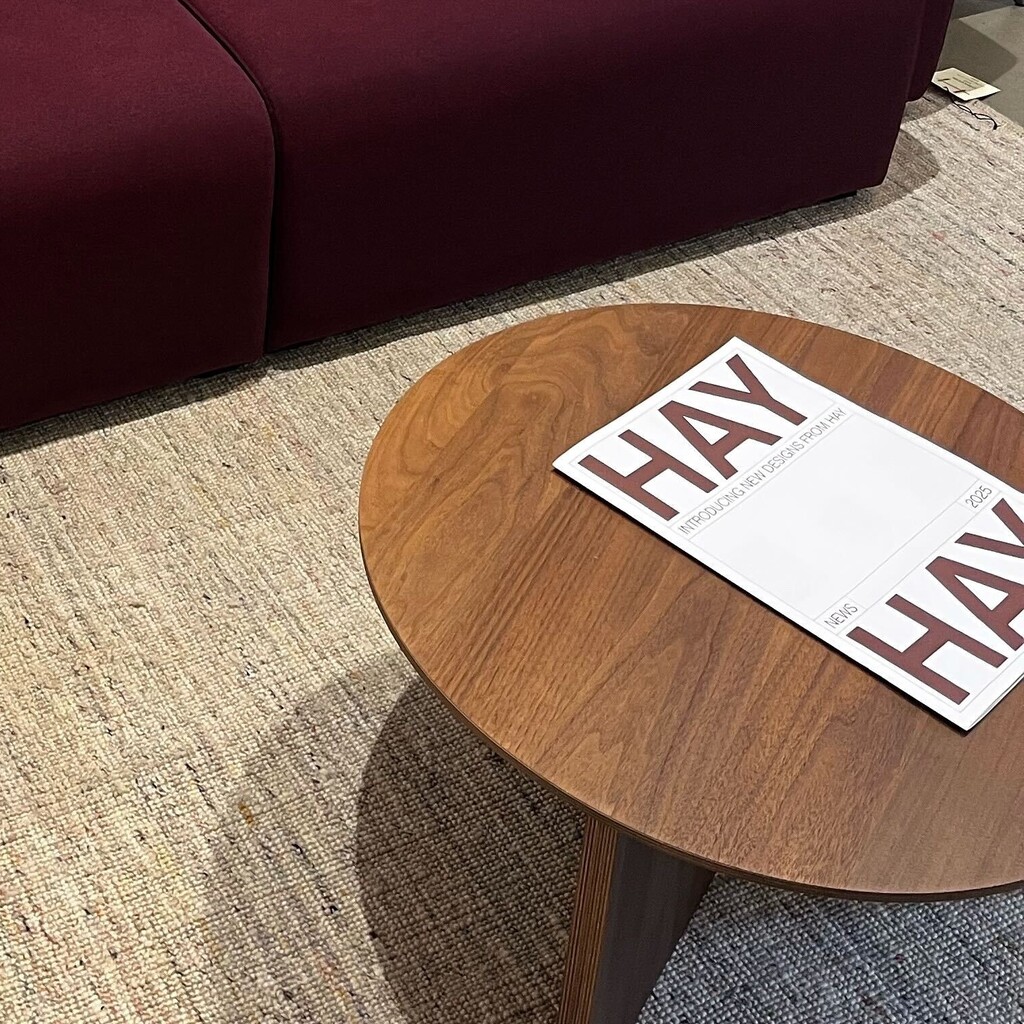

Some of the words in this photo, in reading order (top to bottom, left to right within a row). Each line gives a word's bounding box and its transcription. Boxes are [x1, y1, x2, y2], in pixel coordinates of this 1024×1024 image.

[578, 354, 808, 521] HAY
[678, 487, 745, 535] INTRODUCING
[740, 469, 766, 491] NEW
[761, 441, 805, 474] DESIGNS
[799, 421, 831, 444] FROM
[826, 407, 847, 424] HAY
[965, 485, 993, 509] 2025
[824, 602, 859, 629] NEWS
